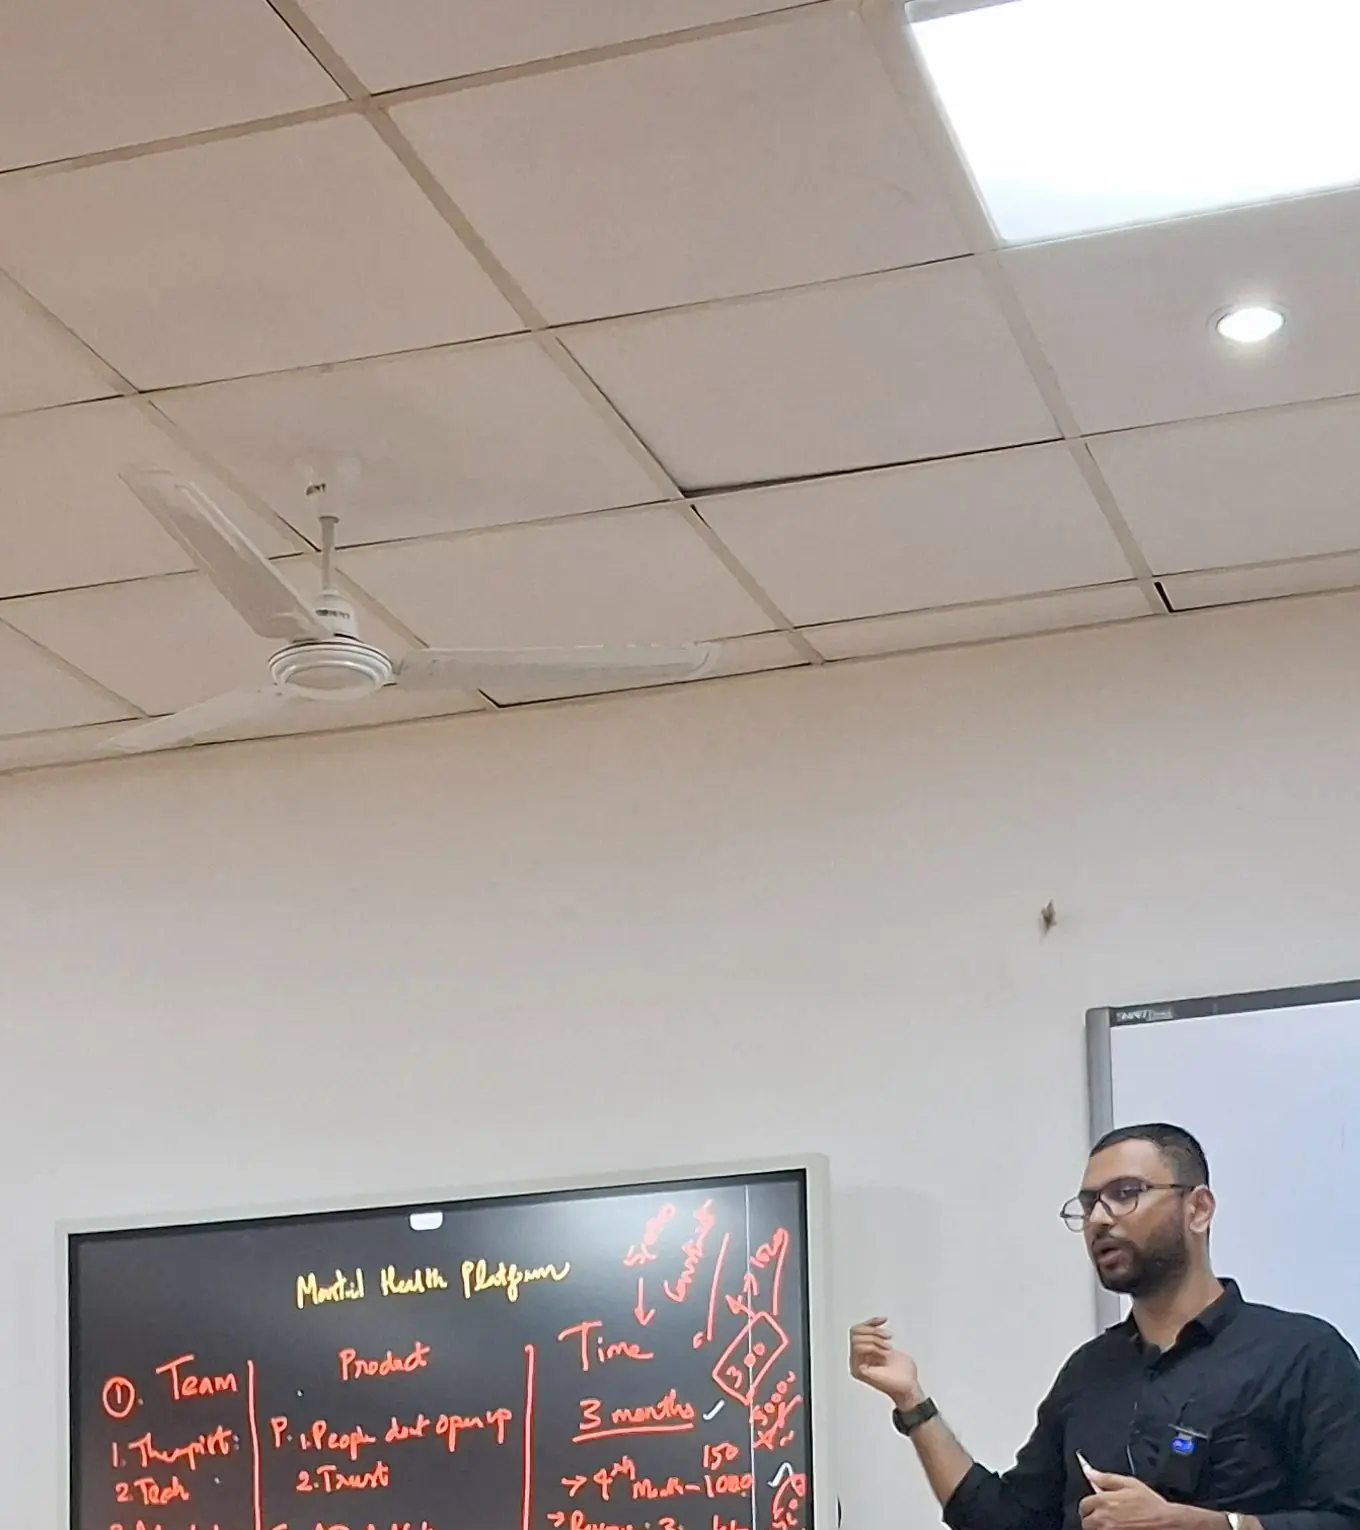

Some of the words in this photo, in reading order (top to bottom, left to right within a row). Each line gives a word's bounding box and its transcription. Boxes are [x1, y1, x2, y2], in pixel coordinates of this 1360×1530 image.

[380, 1264, 448, 1297] Health
[460, 1258, 571, 1303] Platform
[338, 1340, 431, 1381] Product
[557, 1319, 655, 1372] Time
[155, 1354, 238, 1400] Team
[579, 1397, 602, 1431] 3
[611, 1387, 696, 1425] months
[133, 1475, 191, 1505] Tech
[315, 1461, 390, 1494] Trust
